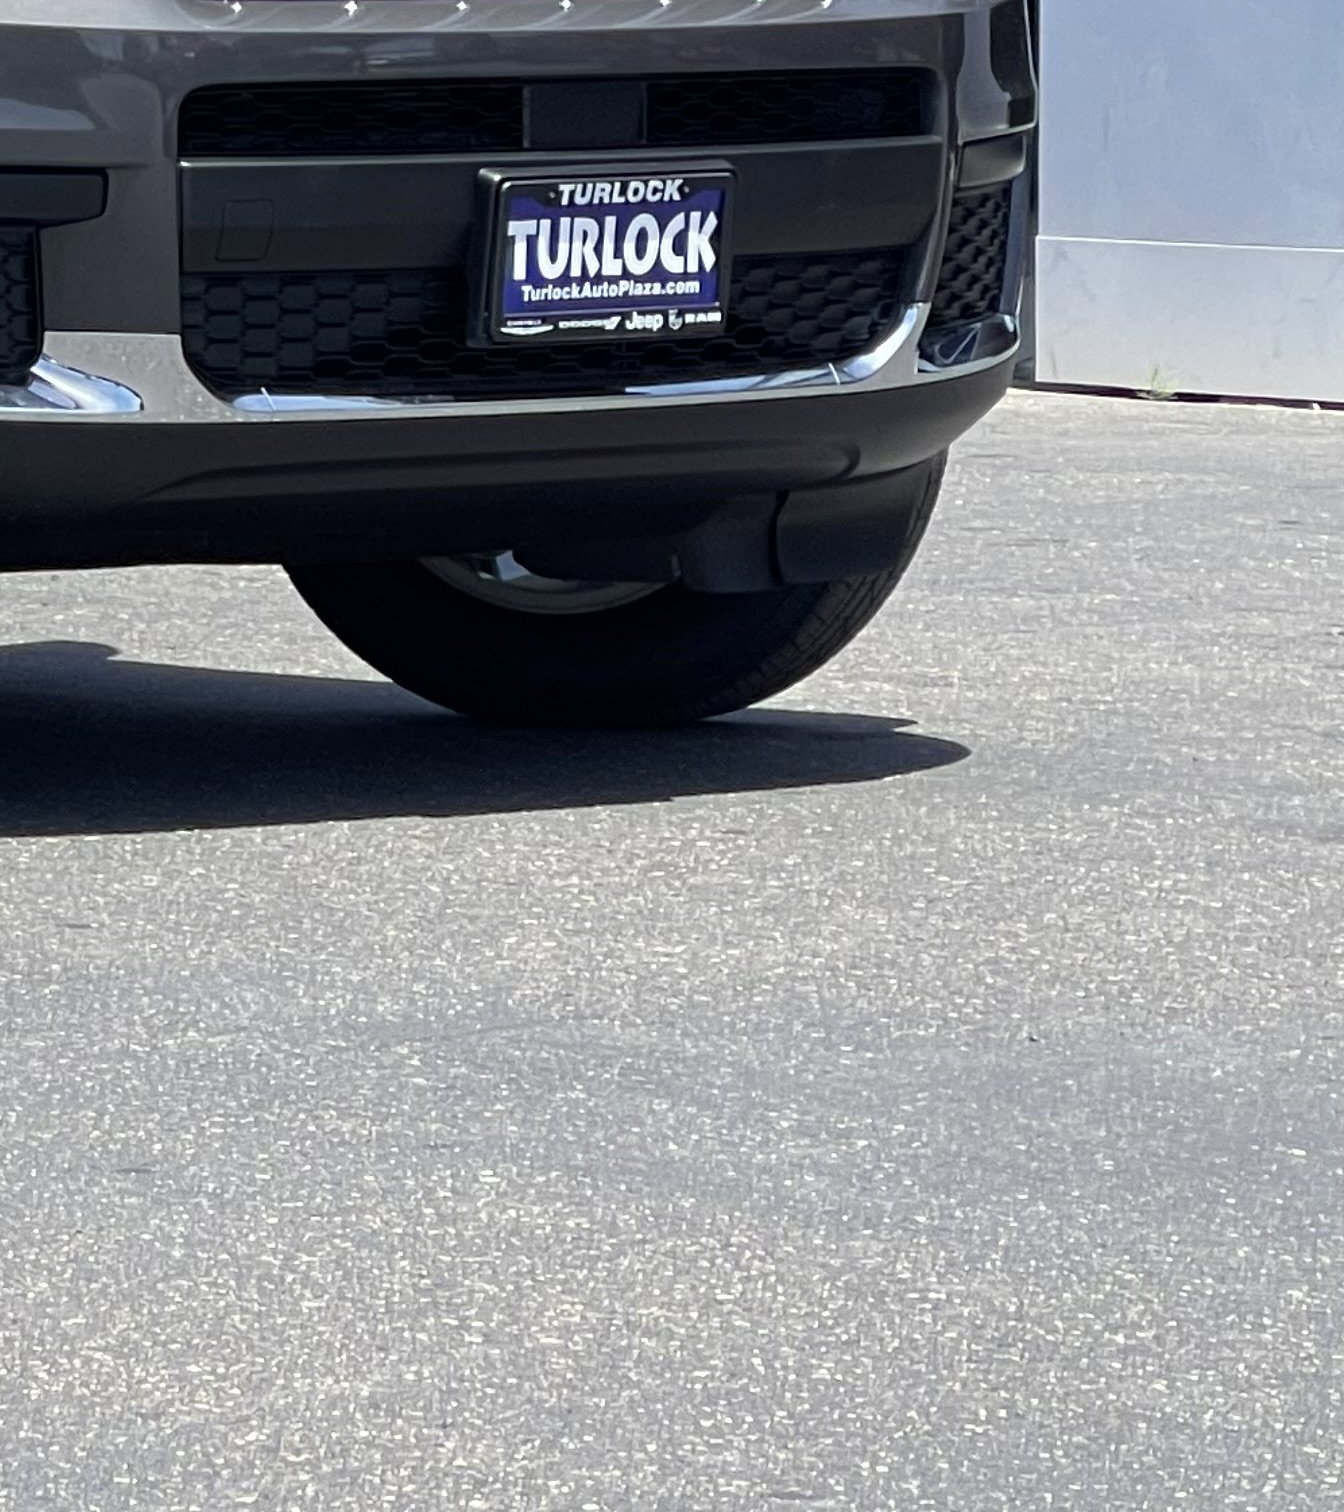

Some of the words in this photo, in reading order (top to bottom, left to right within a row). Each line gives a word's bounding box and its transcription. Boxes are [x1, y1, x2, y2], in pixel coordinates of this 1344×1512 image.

[558, 179, 684, 206] TURLOCK
[507, 211, 718, 281] TURLOCK
[521, 280, 700, 302] TurlockAutoPlaza.com
[625, 311, 664, 332] Jeep
